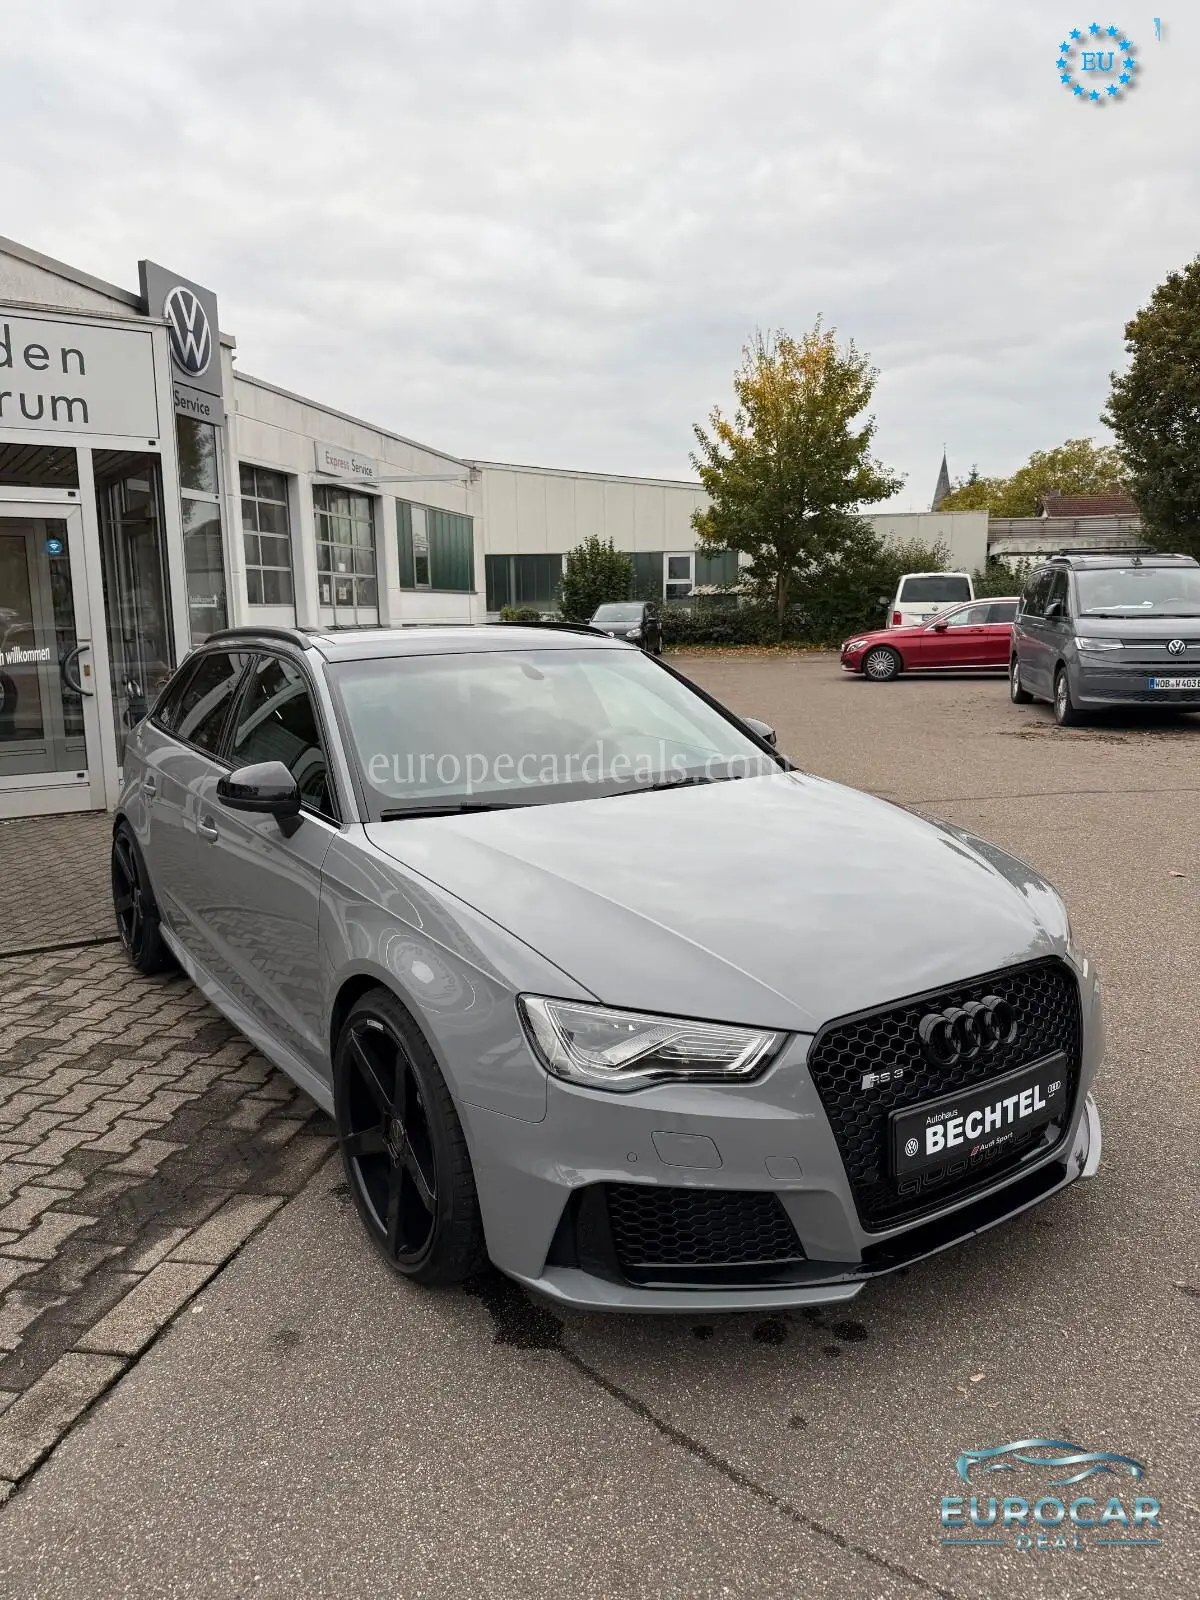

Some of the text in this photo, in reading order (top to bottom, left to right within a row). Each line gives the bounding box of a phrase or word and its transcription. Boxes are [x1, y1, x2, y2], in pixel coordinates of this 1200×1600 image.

[174, 389, 211, 417] Service
[325, 450, 374, 477] Express Service
[5, 645, 51, 665] willkommen
[1155, 679, 1171, 688] WOB
[926, 1108, 958, 1125] Autohaus
[926, 1084, 1046, 1156] BECHTEL
[980, 1131, 1014, 1151] Audi Sport
